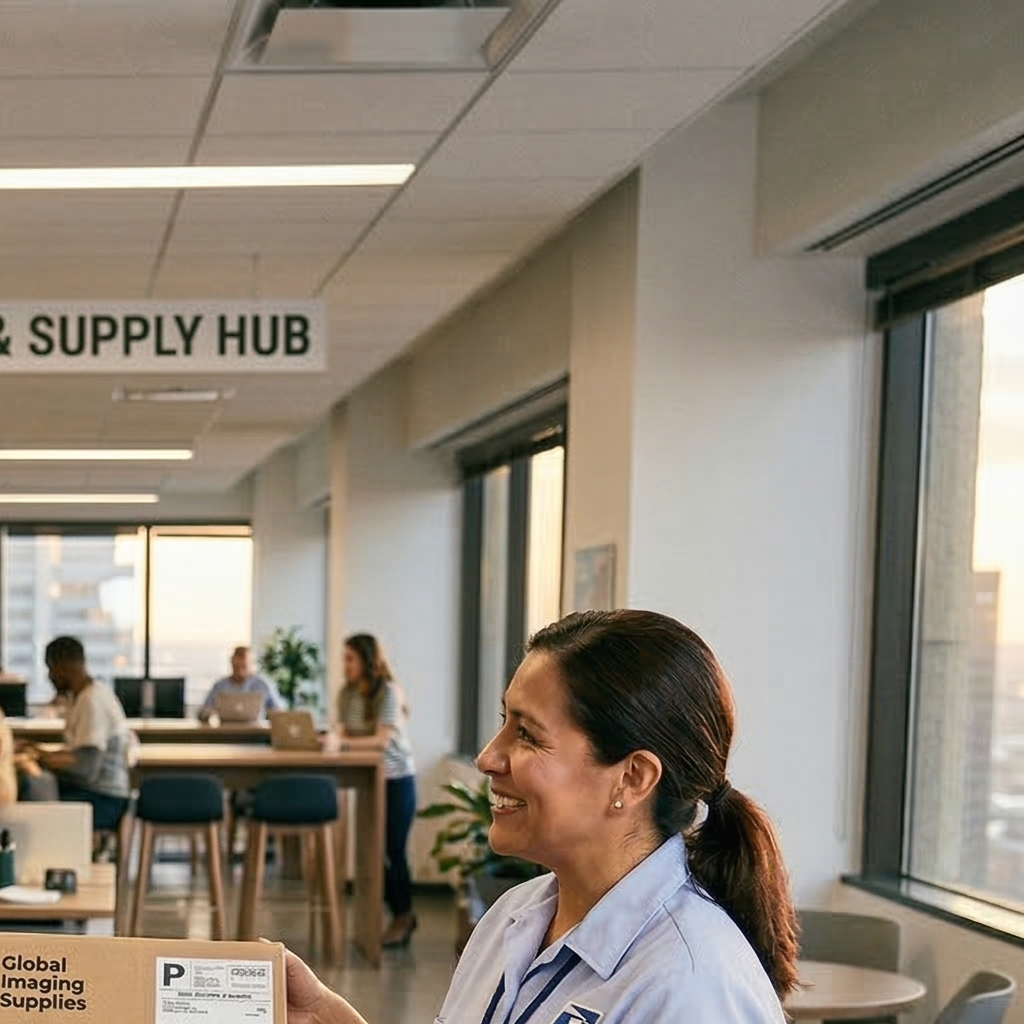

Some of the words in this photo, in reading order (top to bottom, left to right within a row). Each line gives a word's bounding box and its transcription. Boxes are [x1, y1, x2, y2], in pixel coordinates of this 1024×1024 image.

[29, 315, 203, 357] SUPPLY
[218, 315, 311, 357] HUB
[2, 954, 67, 973] Global
[1, 973, 85, 995] Imaging
[163, 963, 185, 987] P
[0, 992, 87, 1013] Supplies
